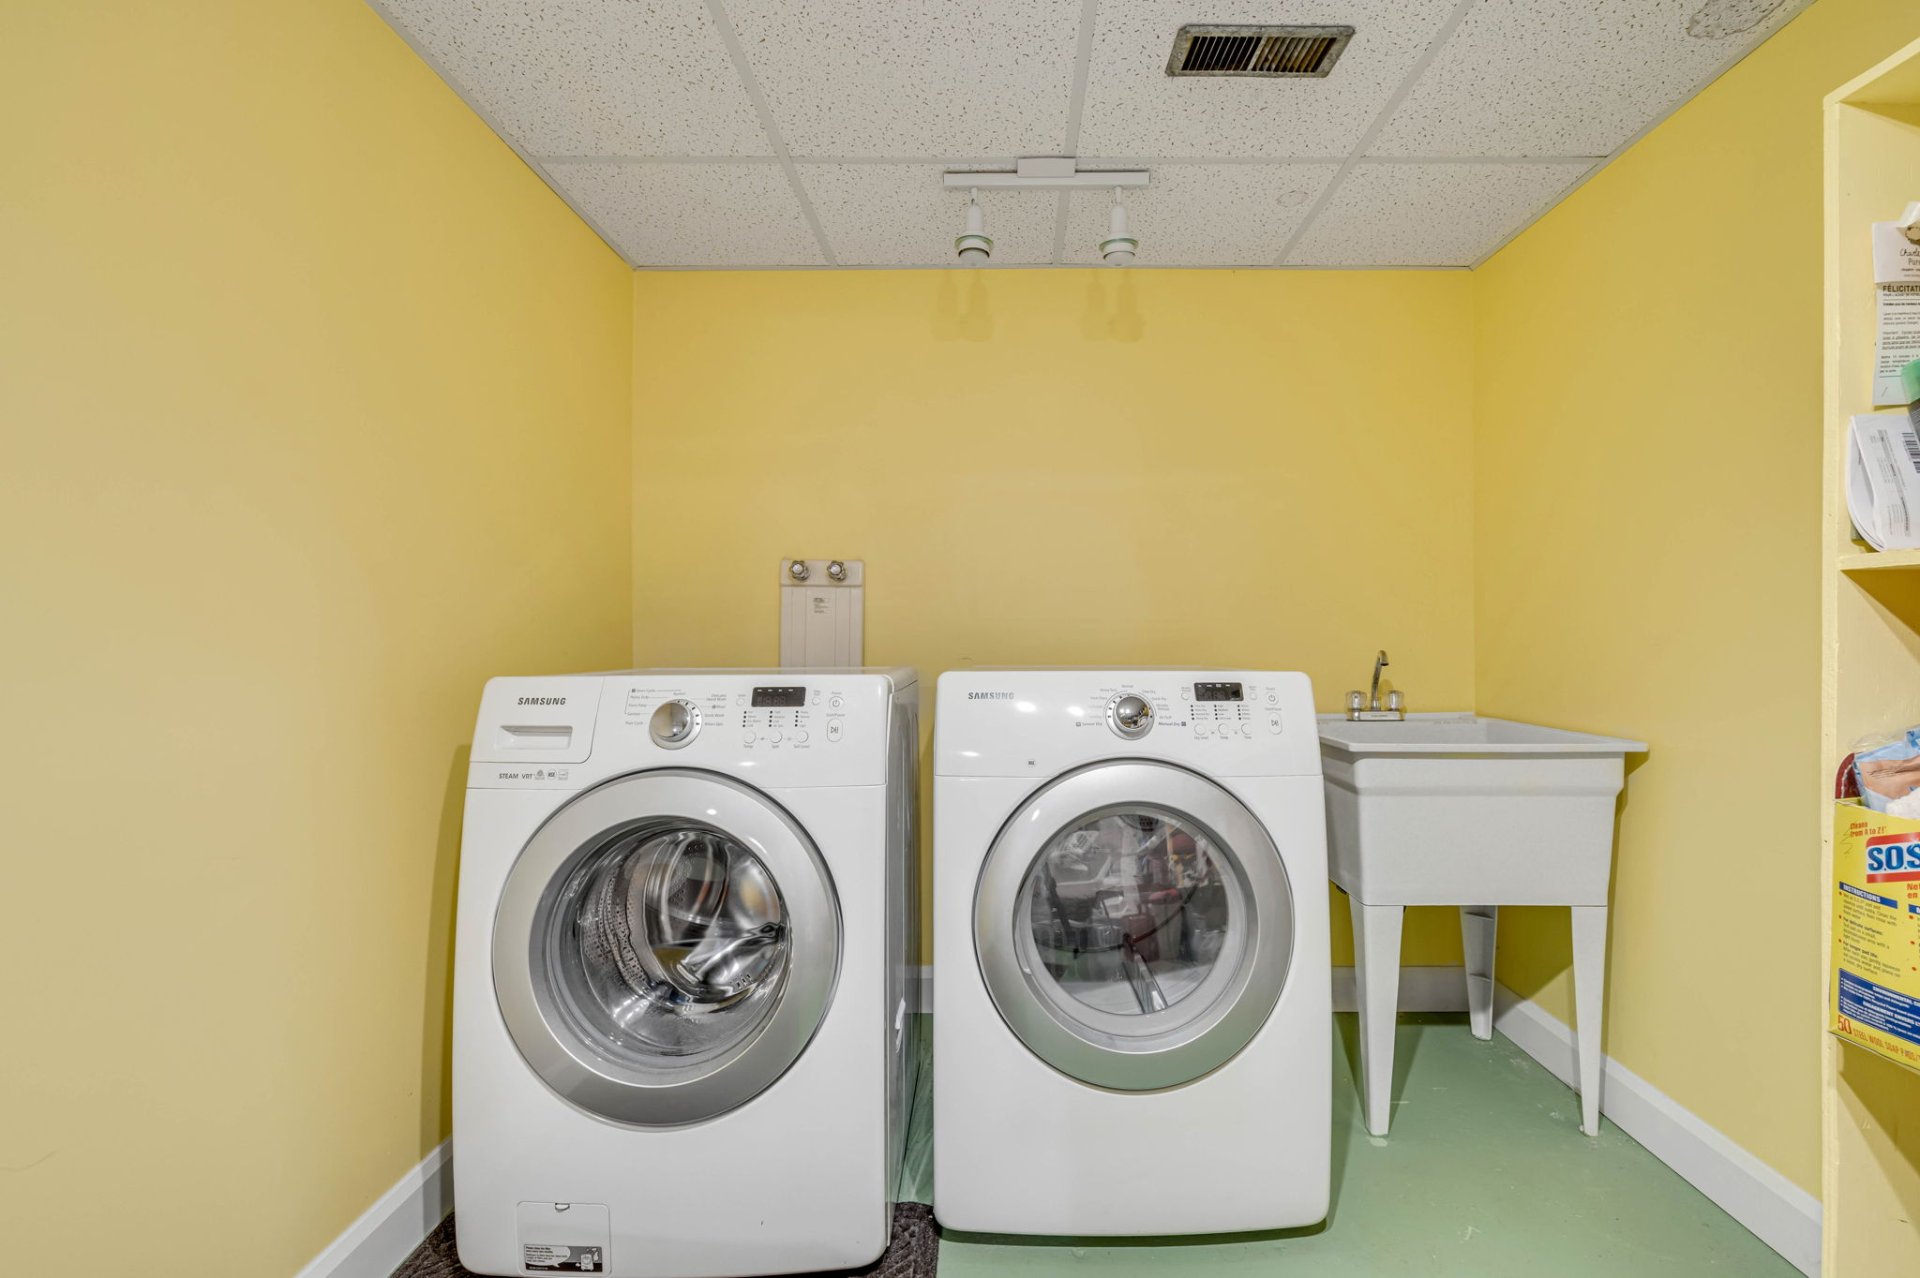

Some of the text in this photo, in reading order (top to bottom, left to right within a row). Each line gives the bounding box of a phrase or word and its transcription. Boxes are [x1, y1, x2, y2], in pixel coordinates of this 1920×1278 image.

[967, 691, 1015, 700] SAMSUNG
[517, 697, 567, 706] SAMSUNG
[1850, 830, 1864, 838] from
[1838, 1014, 1852, 1035] 50
